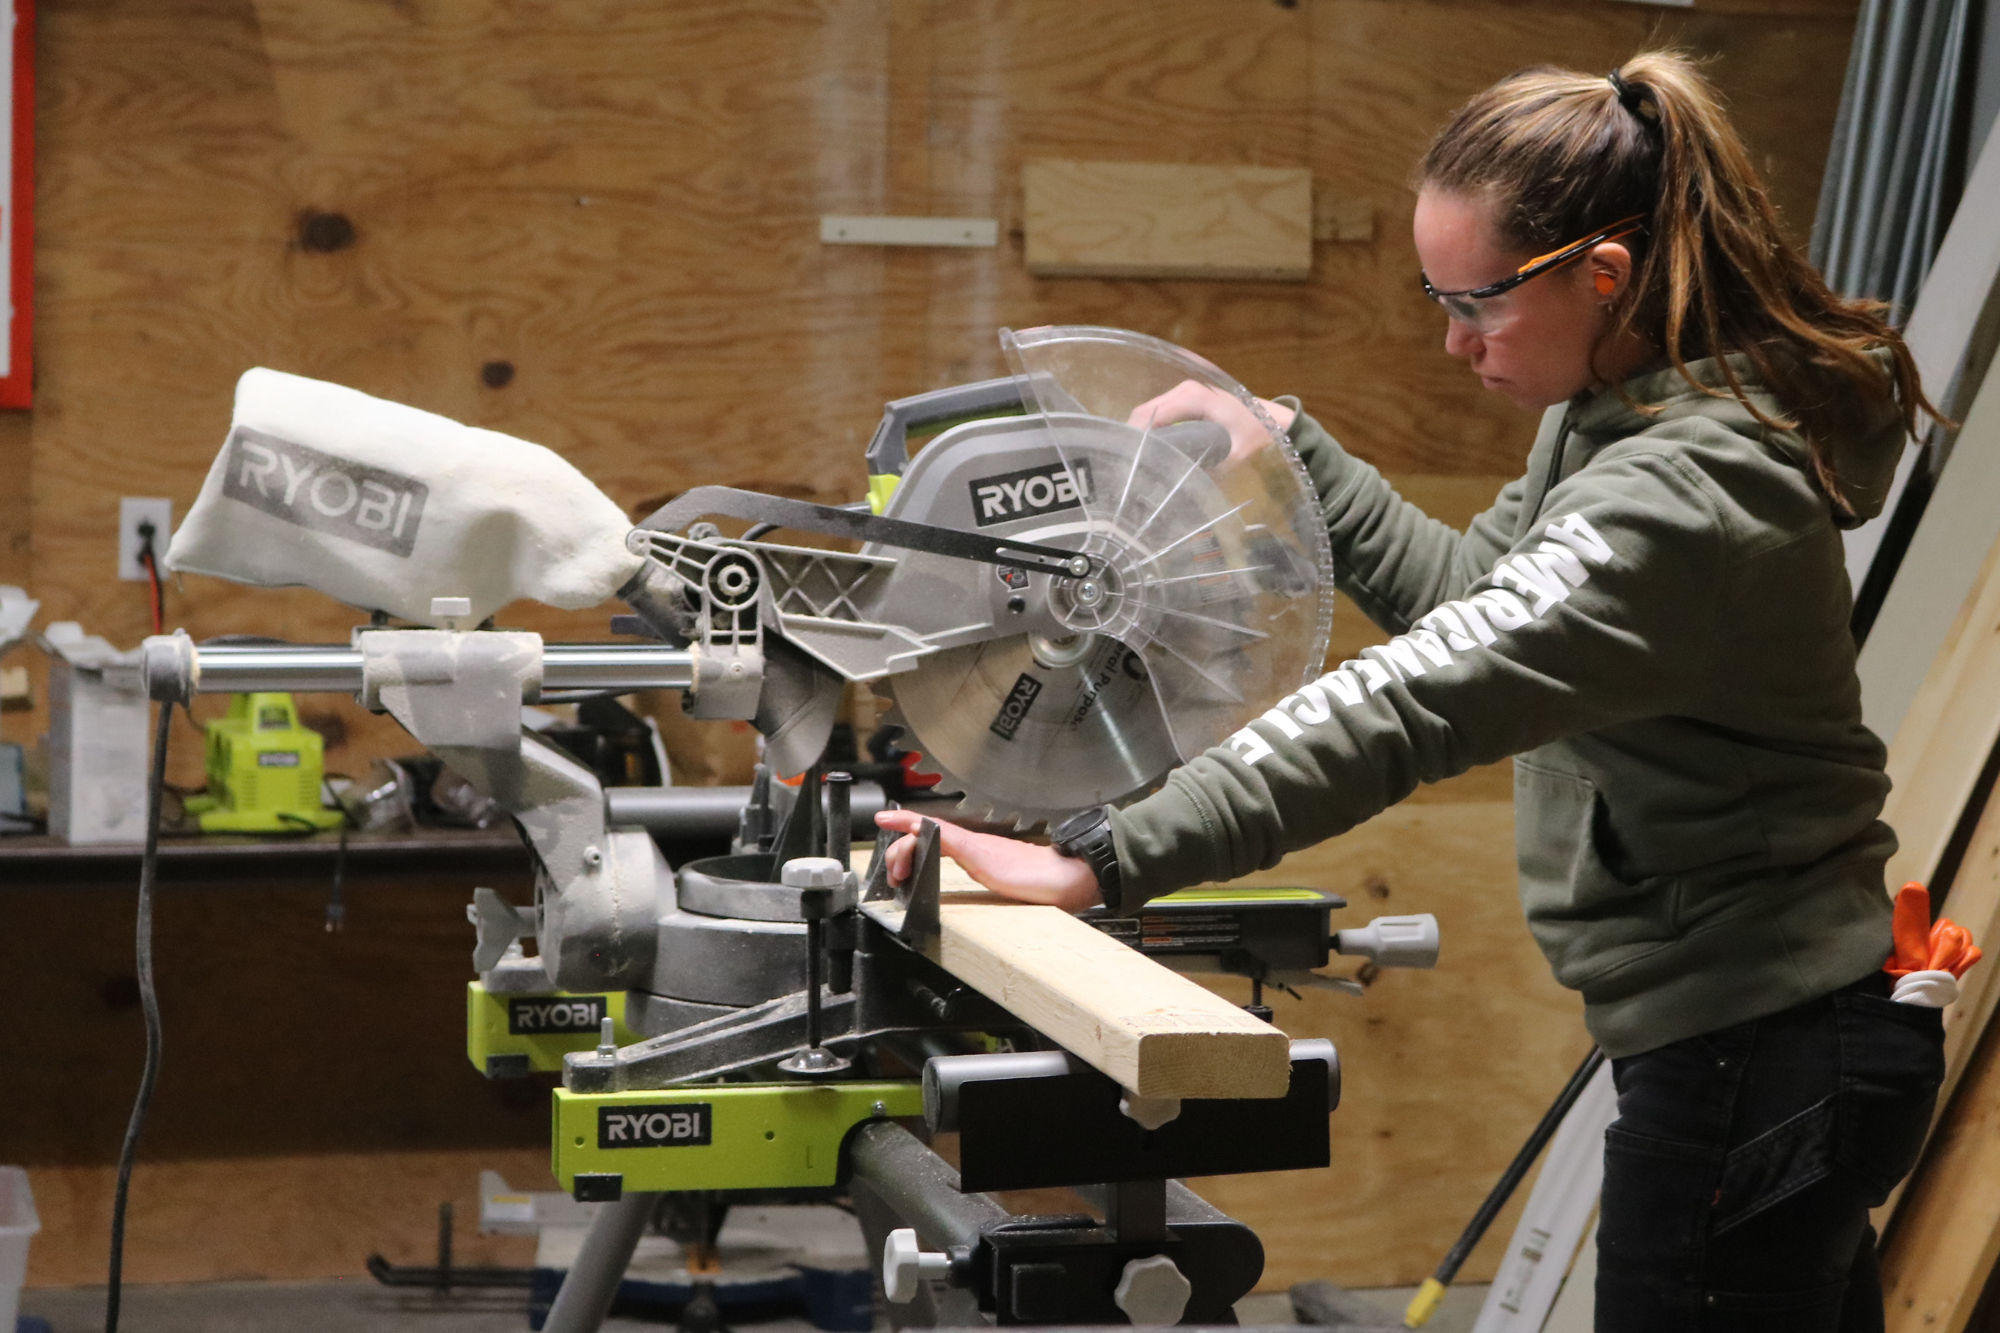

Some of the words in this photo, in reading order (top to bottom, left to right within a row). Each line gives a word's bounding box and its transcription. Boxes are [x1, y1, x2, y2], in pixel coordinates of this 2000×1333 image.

[238, 440, 412, 538] RYOBI
[977, 467, 1090, 518] RYOBI
[996, 678, 1038, 736] RYOBI
[516, 1003, 598, 1027] RYOBI
[606, 1112, 701, 1140] RYOBI
